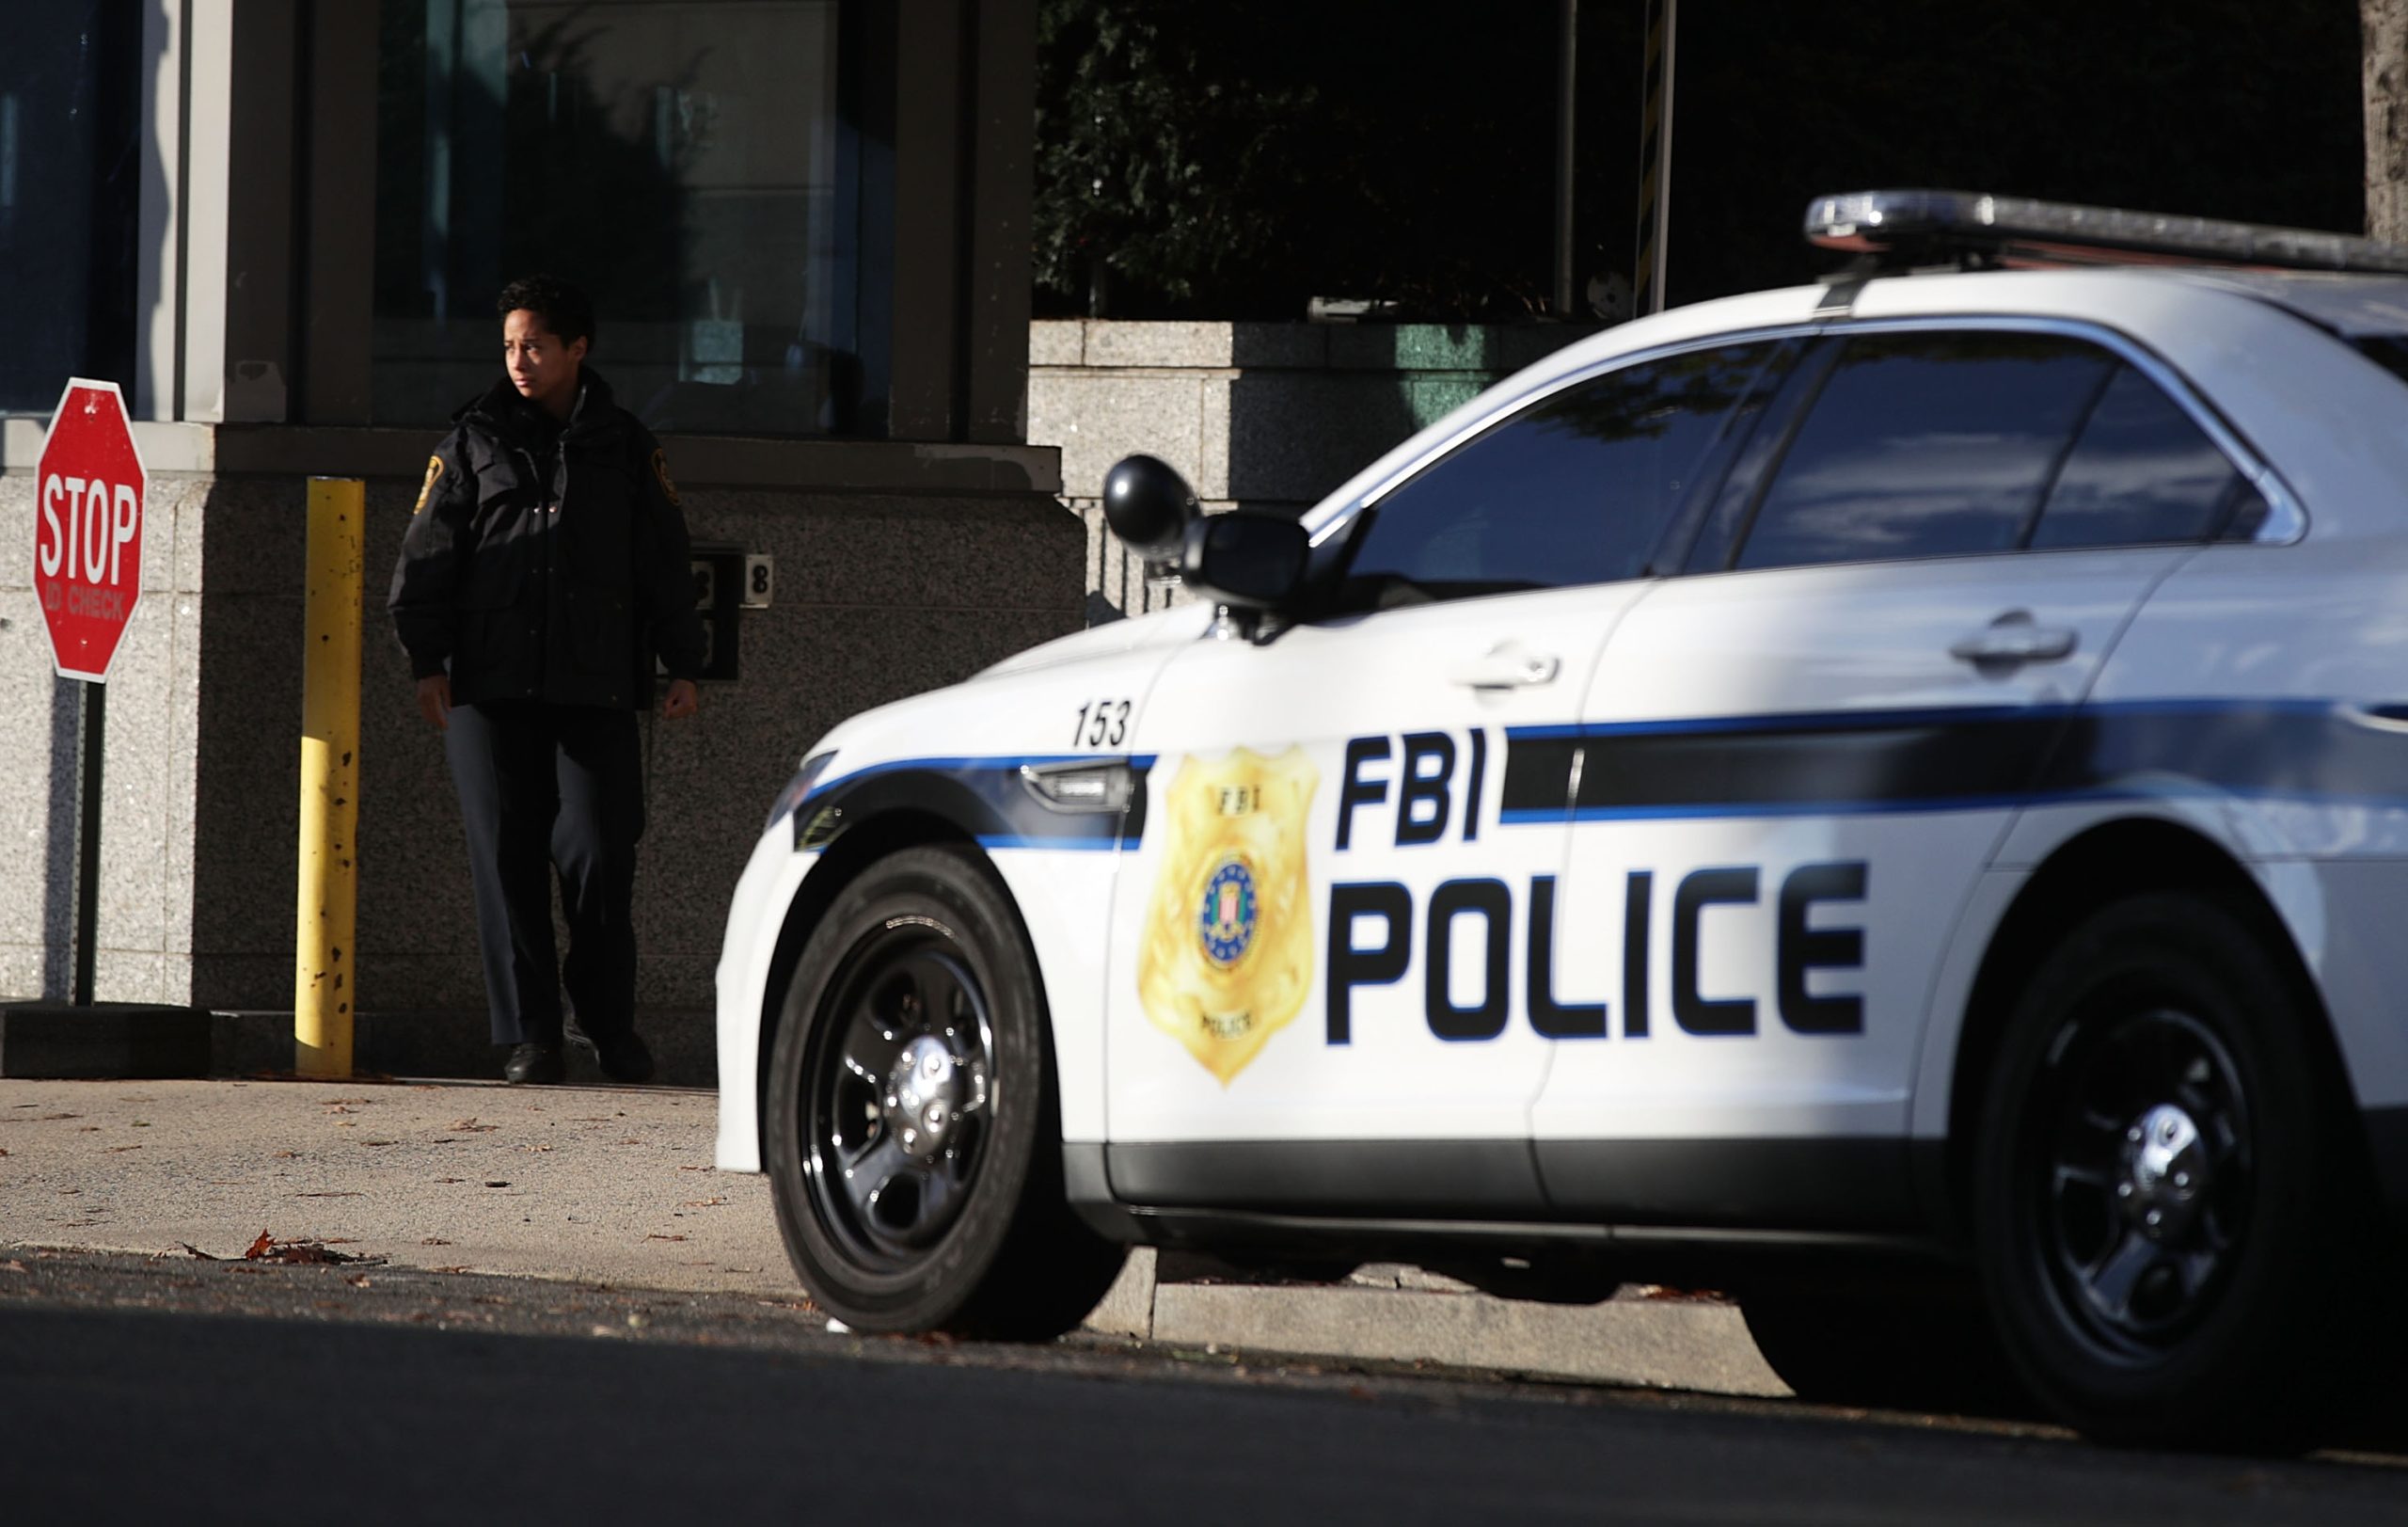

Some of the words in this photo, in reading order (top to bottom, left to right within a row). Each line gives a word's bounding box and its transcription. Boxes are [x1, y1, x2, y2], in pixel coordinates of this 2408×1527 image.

[40, 473, 137, 585] STOP
[46, 581, 61, 611] ID
[68, 584, 125, 621] CHECK
[1073, 700, 1131, 747] 153
[1335, 727, 1485, 851] FBI
[1326, 860, 1869, 1046] POLICE
